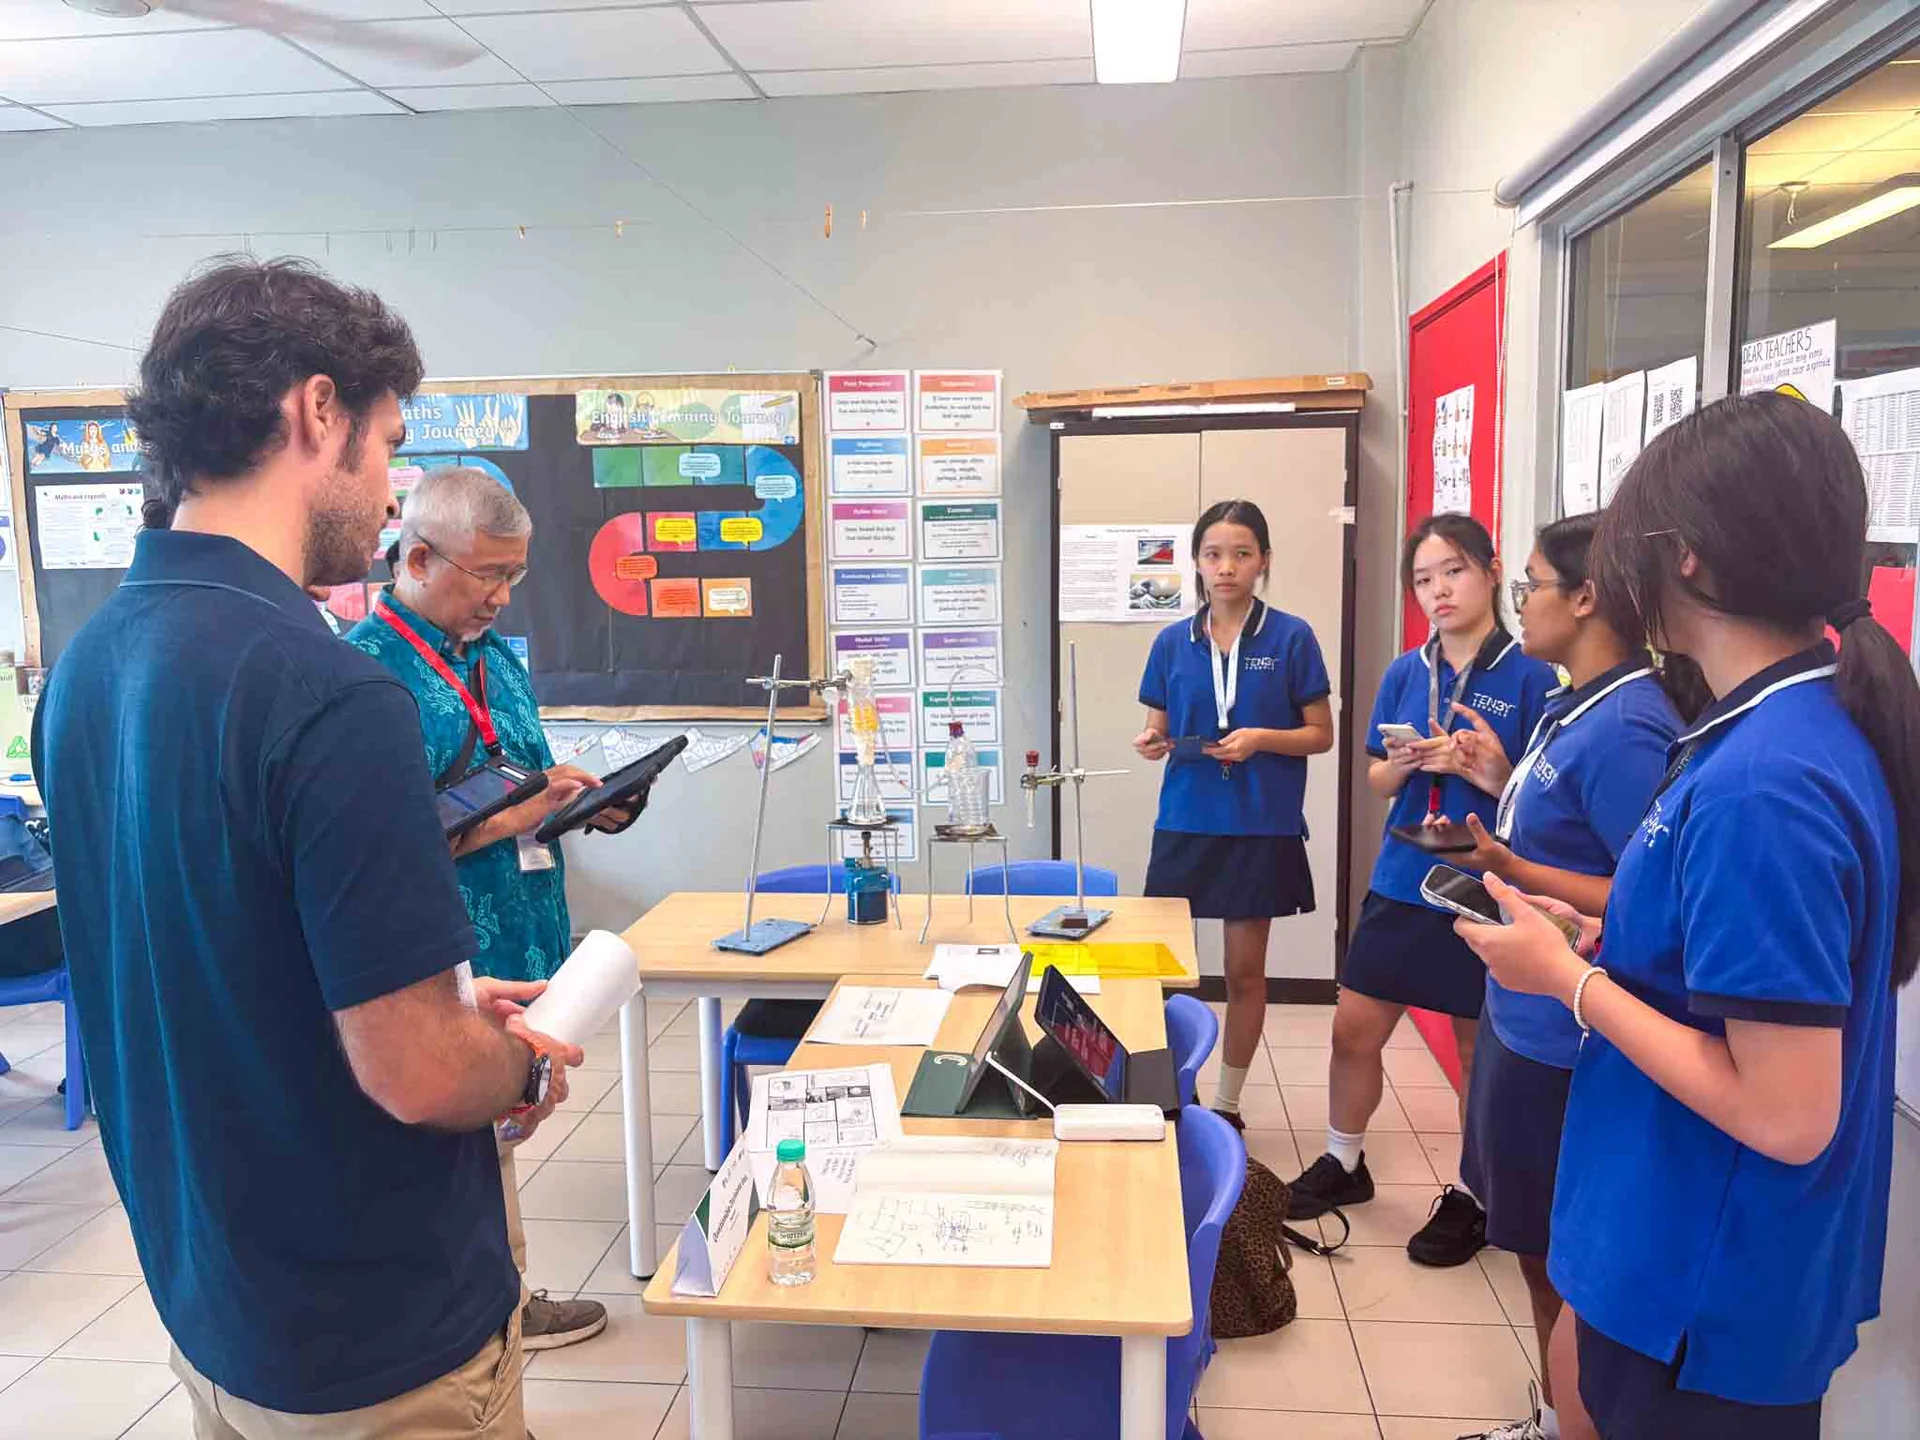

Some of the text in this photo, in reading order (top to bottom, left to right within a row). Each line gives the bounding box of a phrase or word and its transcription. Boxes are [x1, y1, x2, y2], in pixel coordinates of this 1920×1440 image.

[1743, 342, 1763, 364] DEAR
[1765, 328, 1812, 360] TEACHERS
[402, 404, 442, 421] aths
[592, 408, 786, 427] English Learning Journey
[421, 423, 497, 443] Journey
[62, 441, 106, 458] Myths
[1473, 692, 1516, 714] TENBY
